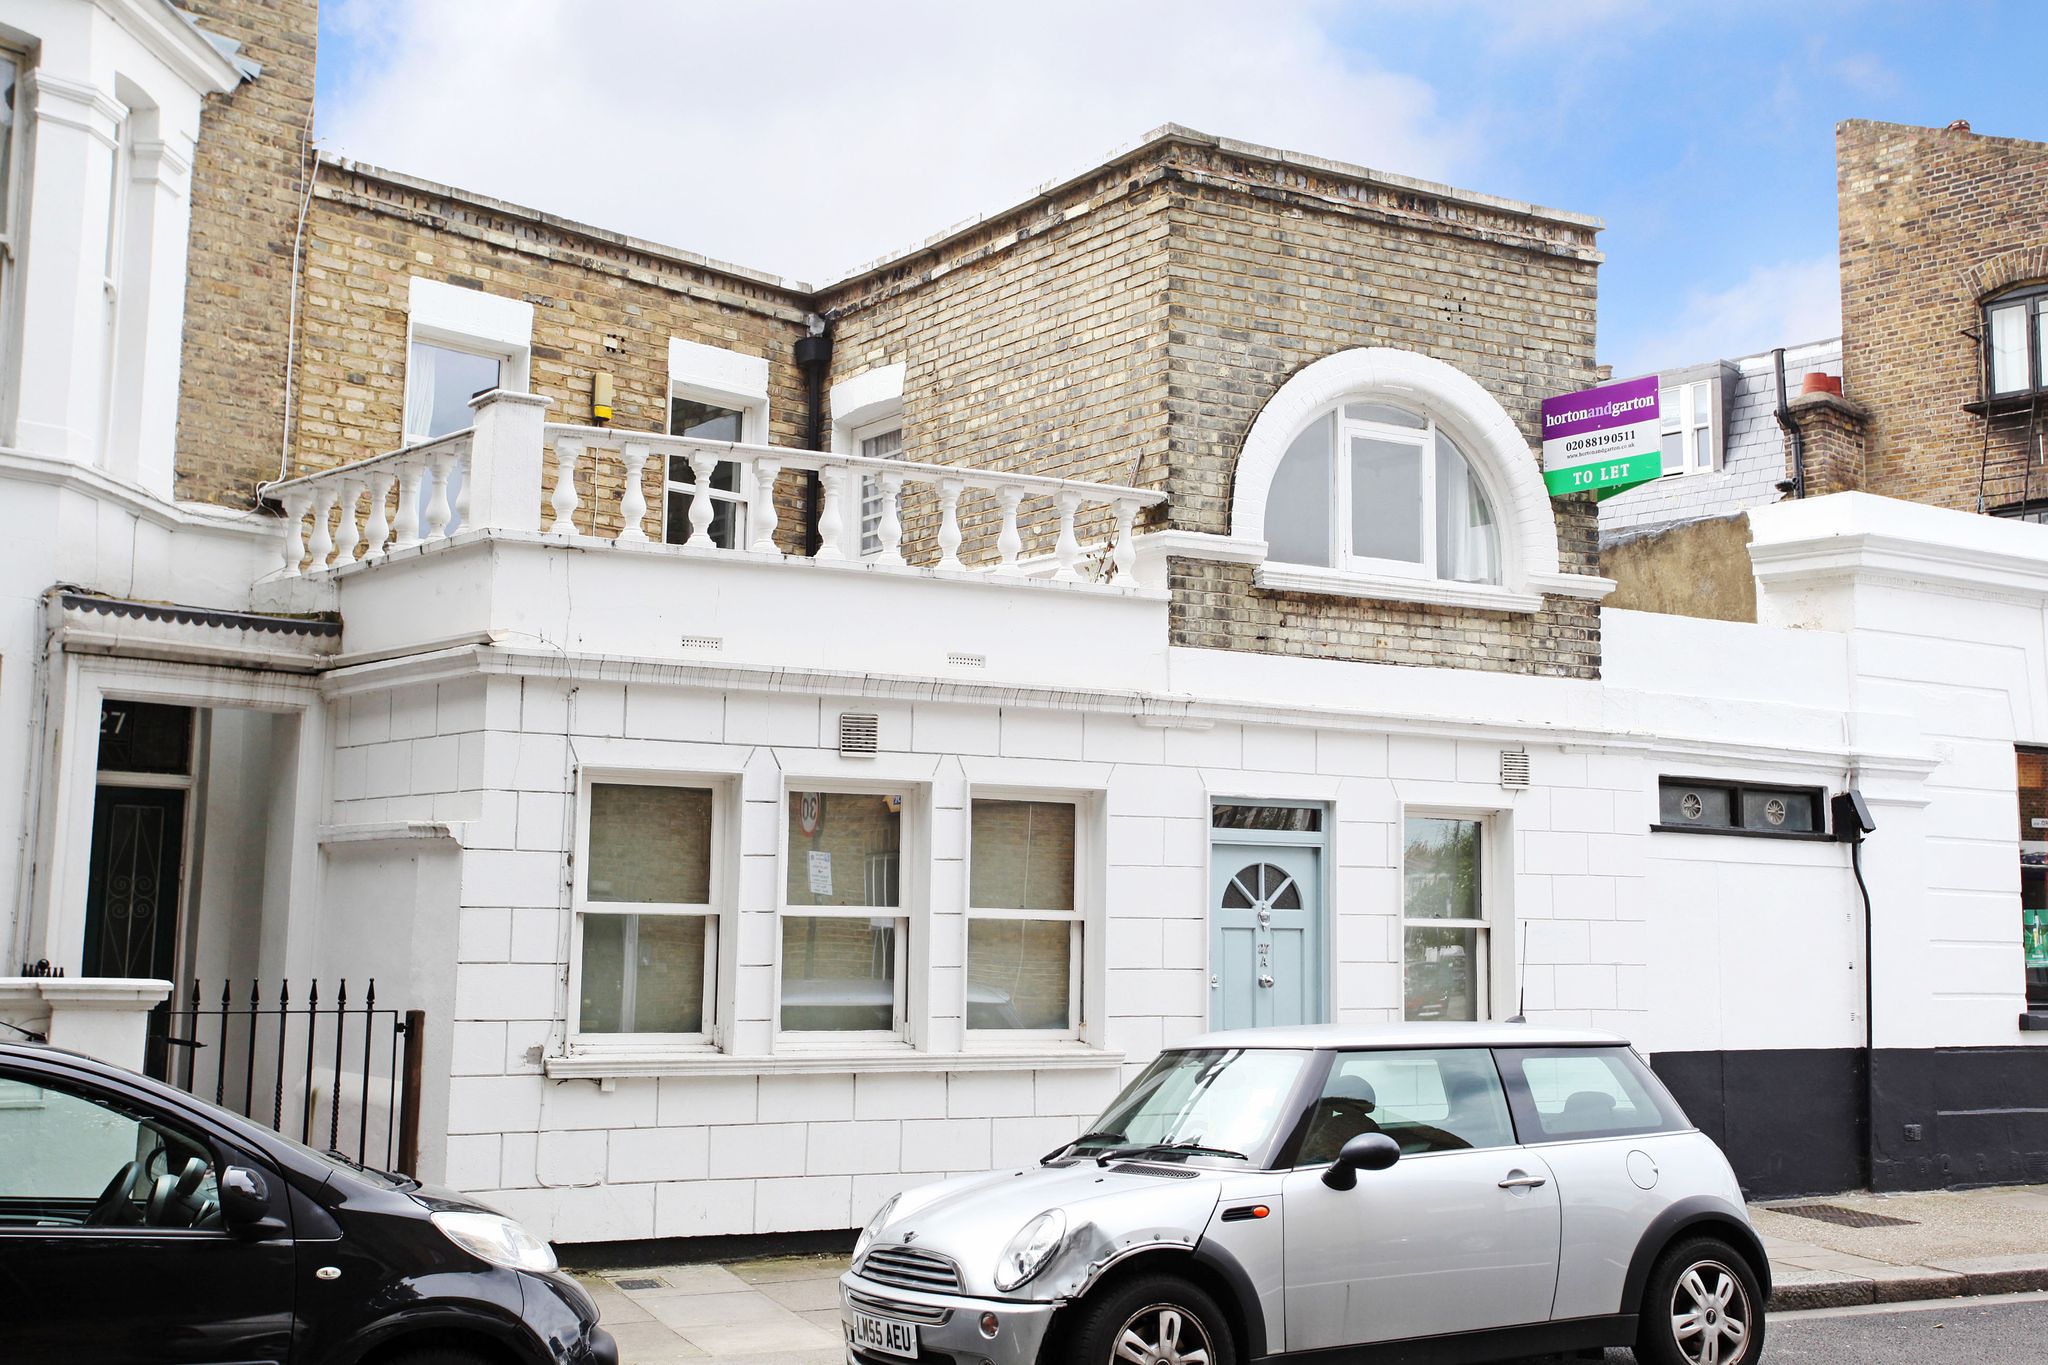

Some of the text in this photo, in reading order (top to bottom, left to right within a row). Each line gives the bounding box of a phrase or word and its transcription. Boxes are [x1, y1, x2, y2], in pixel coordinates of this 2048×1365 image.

[1546, 395, 1655, 427] hortonandgarton
[1565, 430, 1635, 452] 020 8819 0511
[1566, 442, 1635, 459] www.hortonandgarton.co.uk
[1573, 463, 1630, 485] TO LET
[857, 1315, 911, 1352] LM55 AEU
